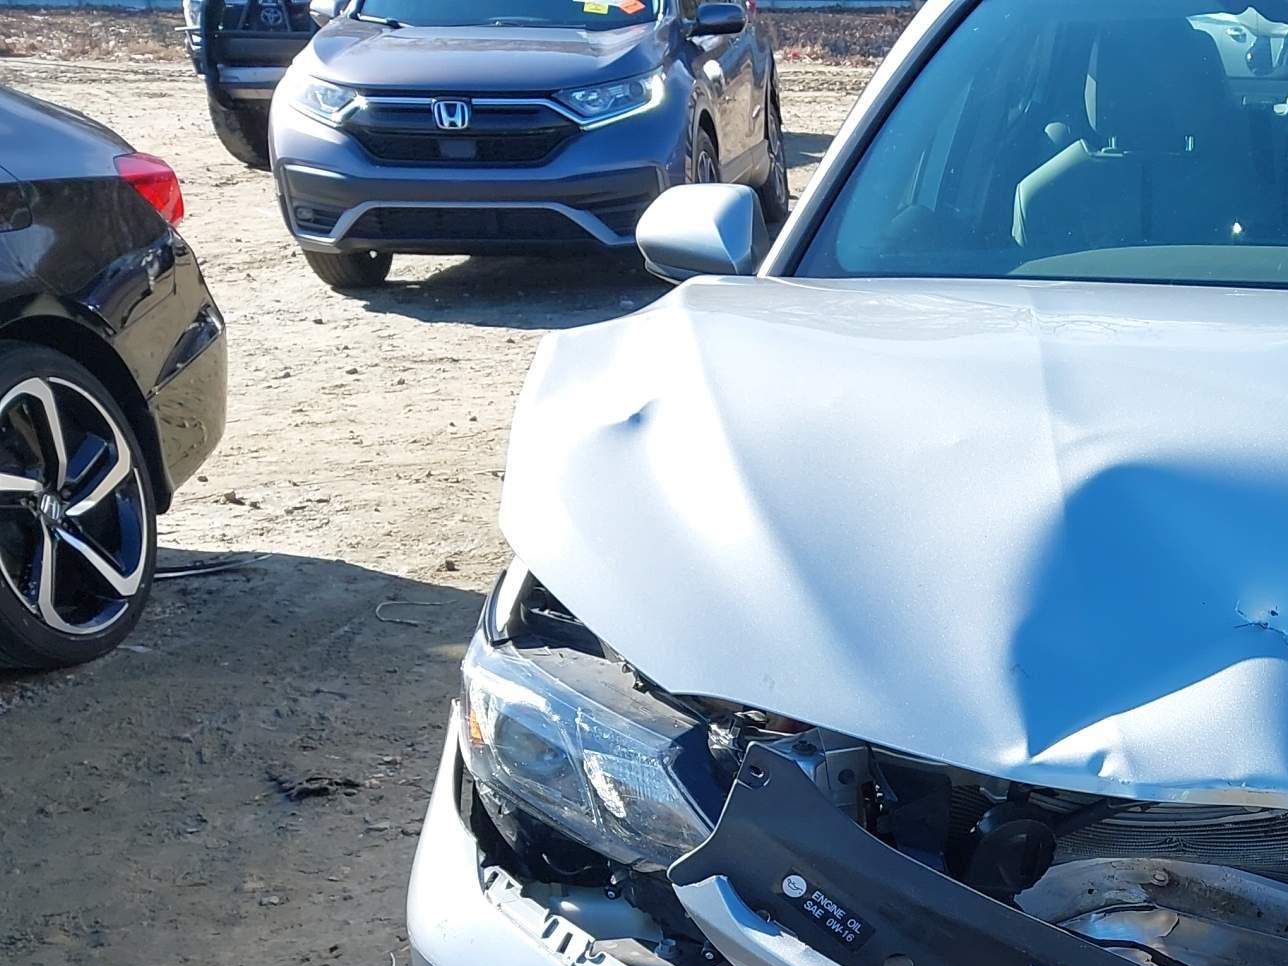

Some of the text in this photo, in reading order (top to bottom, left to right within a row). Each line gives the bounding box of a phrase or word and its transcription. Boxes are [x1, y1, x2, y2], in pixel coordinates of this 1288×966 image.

[803, 900, 855, 942] SAE 0W-16
[811, 890, 862, 934] ENGINE OIL
